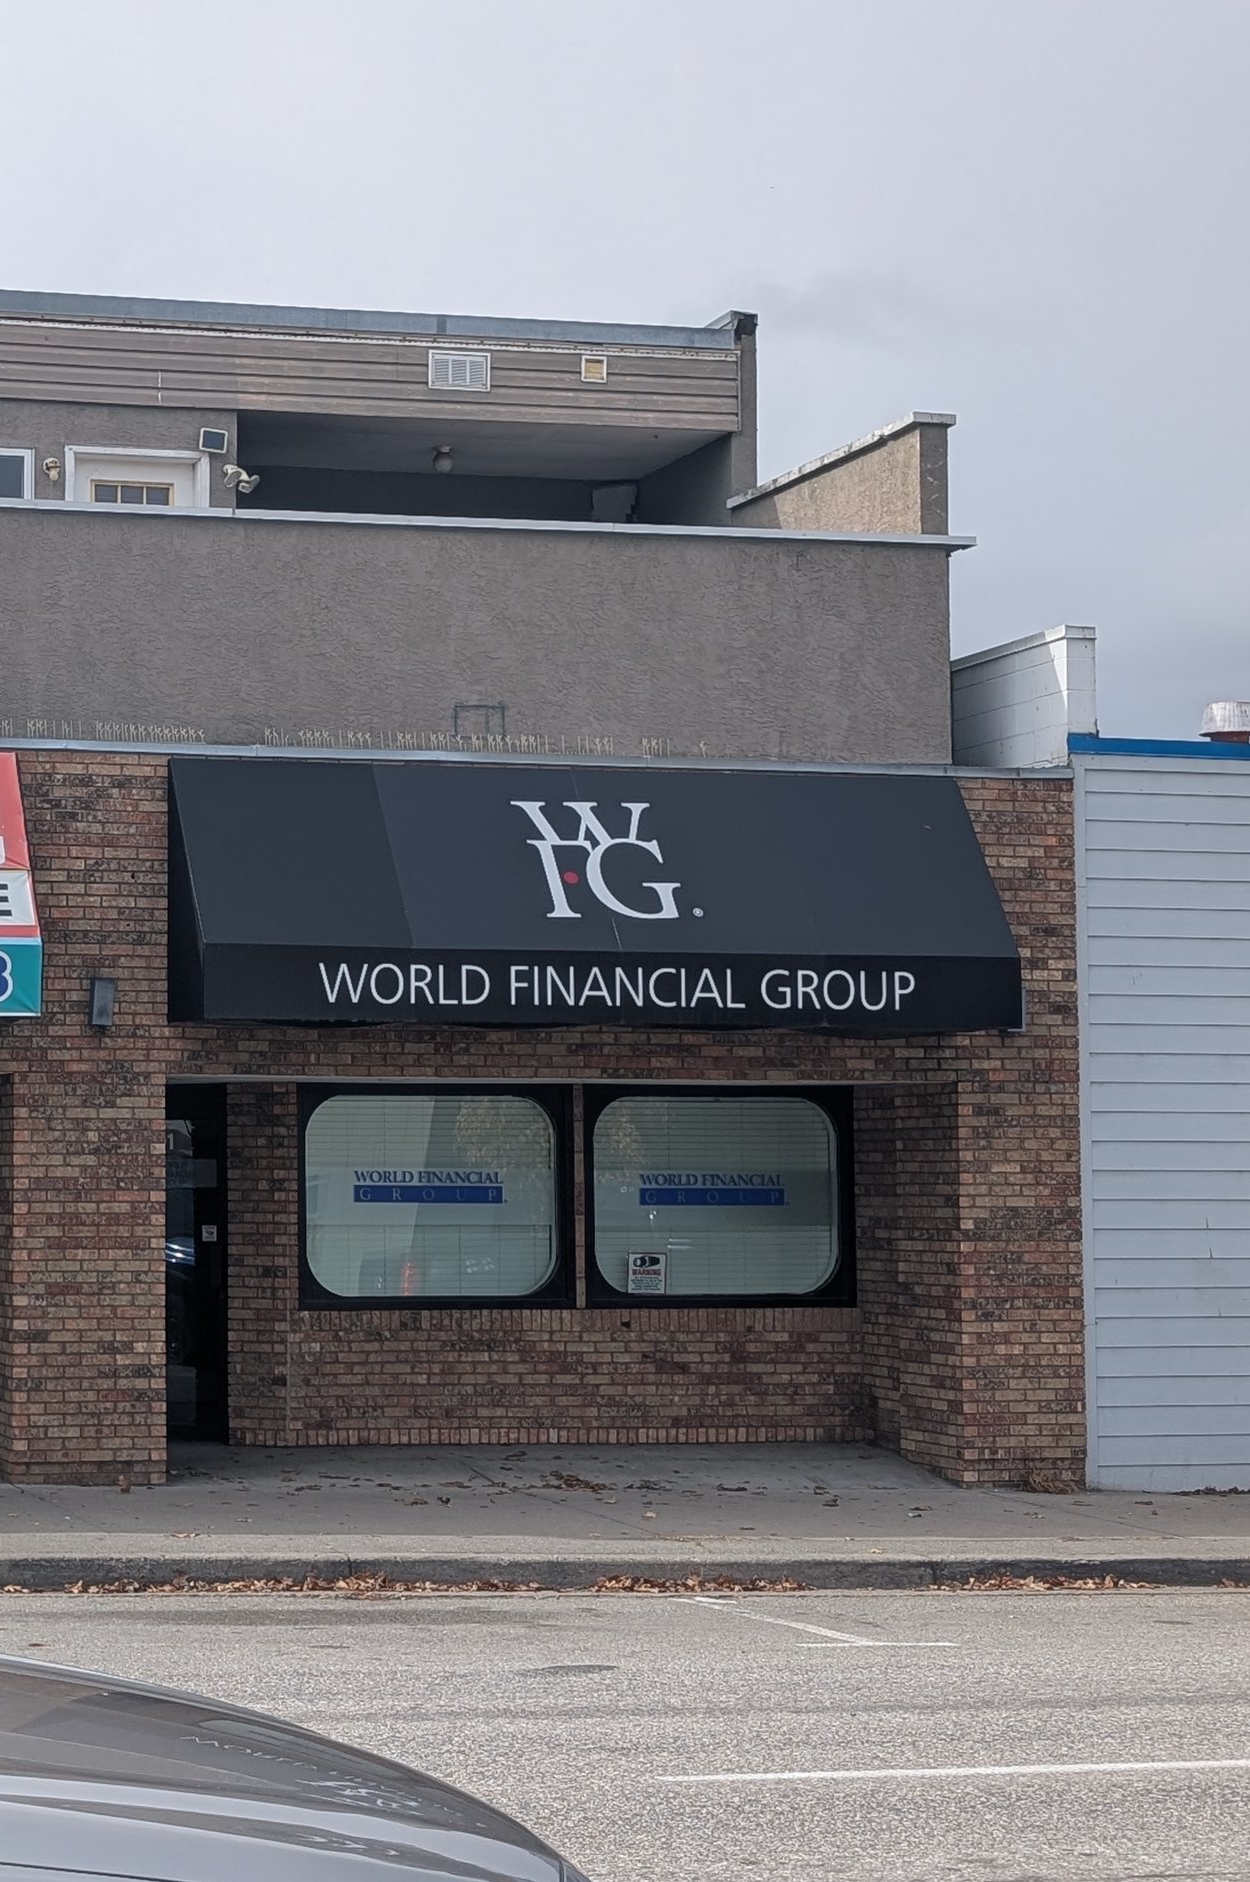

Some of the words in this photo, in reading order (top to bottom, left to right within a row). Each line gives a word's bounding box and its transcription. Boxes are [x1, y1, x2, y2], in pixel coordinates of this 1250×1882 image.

[318, 962, 491, 1005] WORLD
[509, 965, 747, 1009] FINANCIAL
[759, 969, 917, 1012] GROUP
[354, 1170, 415, 1185] WORLD
[418, 1170, 504, 1185] FINANCIAL
[640, 1173, 699, 1188] WORLD
[701, 1173, 786, 1188] FINANCIAL
[359, 1187, 497, 1202] GROUP
[645, 1190, 780, 1205] GROUP
